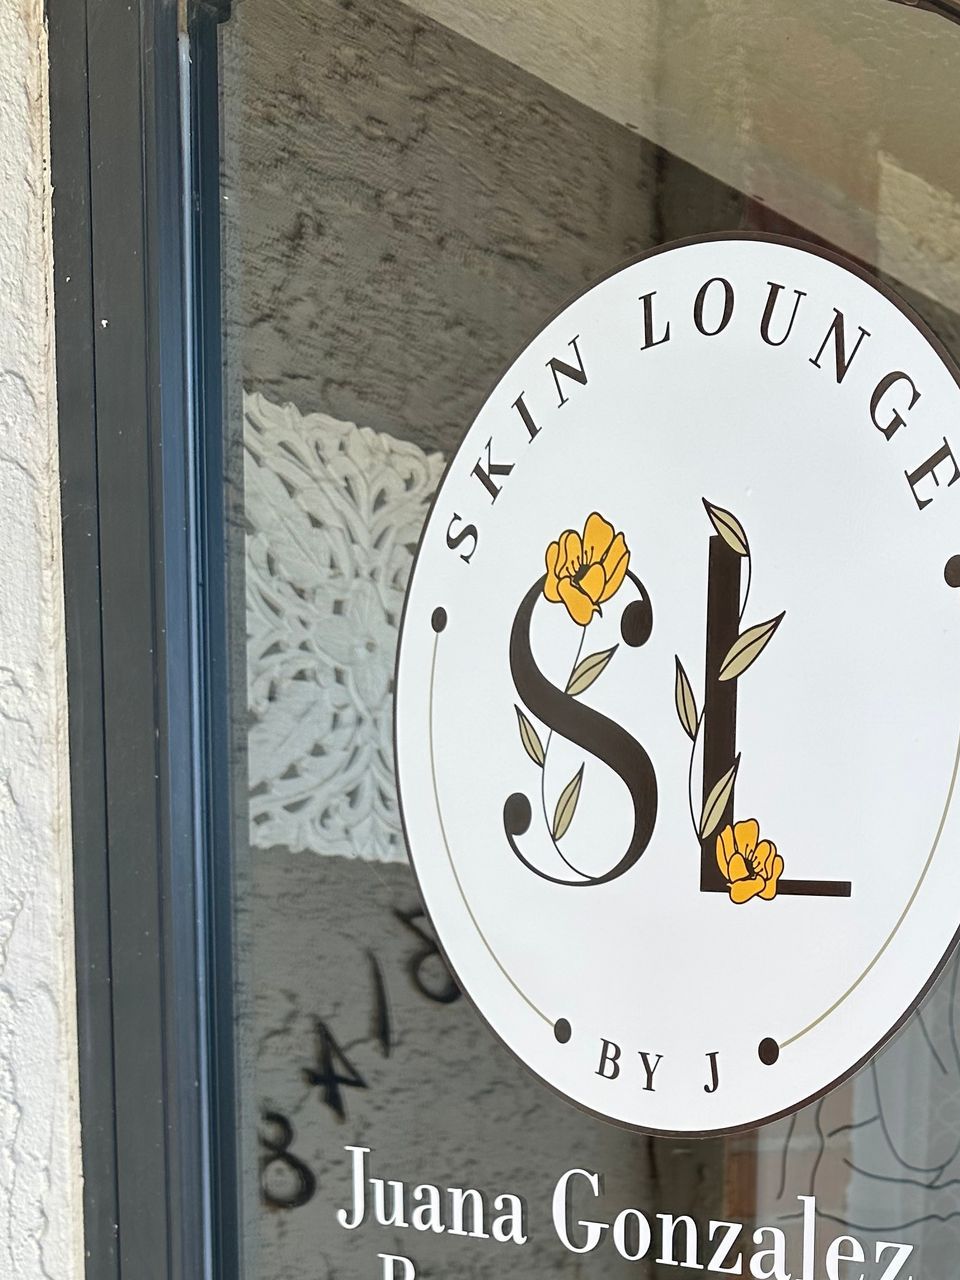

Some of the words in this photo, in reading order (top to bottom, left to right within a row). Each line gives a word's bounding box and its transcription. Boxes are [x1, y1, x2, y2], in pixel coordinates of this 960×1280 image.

[447, 335, 588, 564] SKIN
[594, 1037, 664, 1092] BY
[703, 1051, 721, 1094] J
[337, 1145, 528, 1245] Juana
